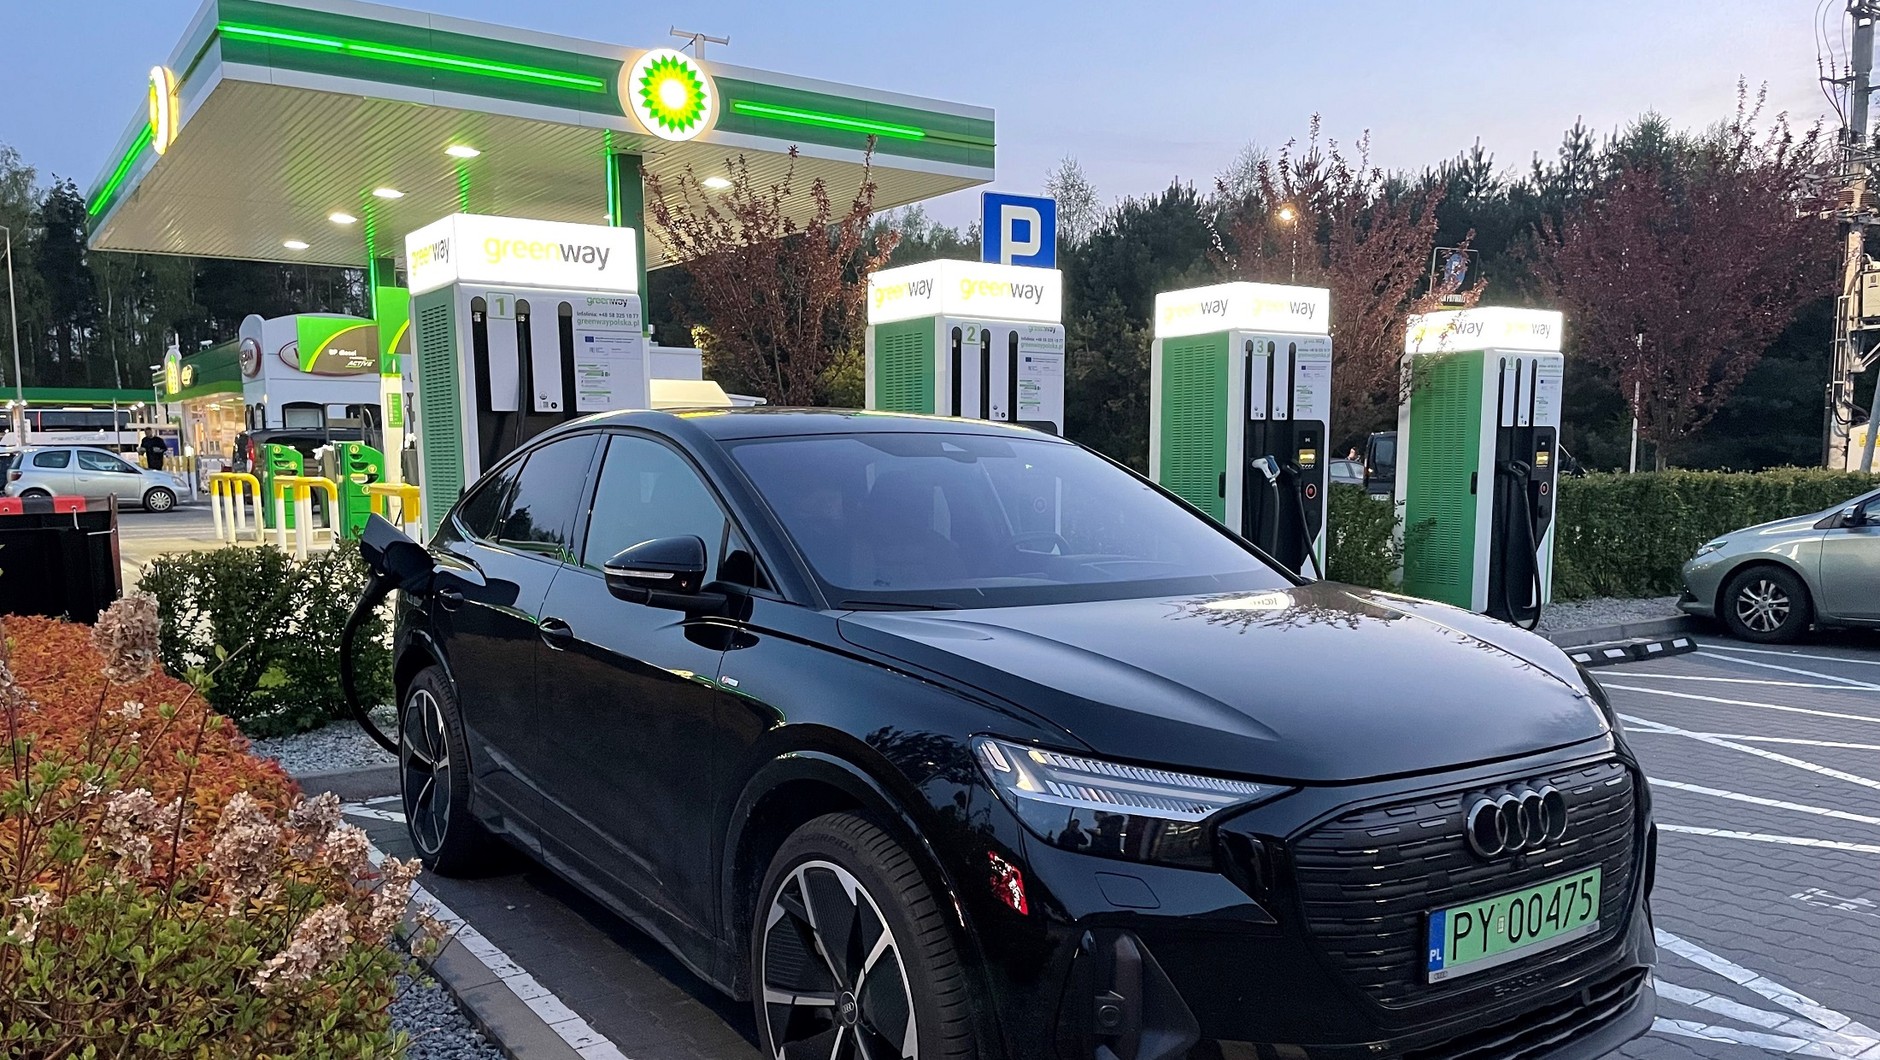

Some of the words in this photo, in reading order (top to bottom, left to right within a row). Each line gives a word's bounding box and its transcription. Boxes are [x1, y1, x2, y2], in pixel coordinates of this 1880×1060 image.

[1001, 204, 1042, 267] P
[411, 237, 450, 276] greenway
[483, 236, 610, 271] greenway
[586, 296, 628, 307] greenway
[875, 277, 934, 308] greenway
[960, 277, 1044, 304] greenway
[494, 297, 506, 316] 1
[576, 318, 640, 327] greenwaypolska.pl
[966, 326, 976, 342] 2
[1256, 338, 1264, 354] 3
[1452, 904, 1496, 961] PY
[1507, 875, 1594, 944] 00475
[1429, 948, 1442, 963] PL
